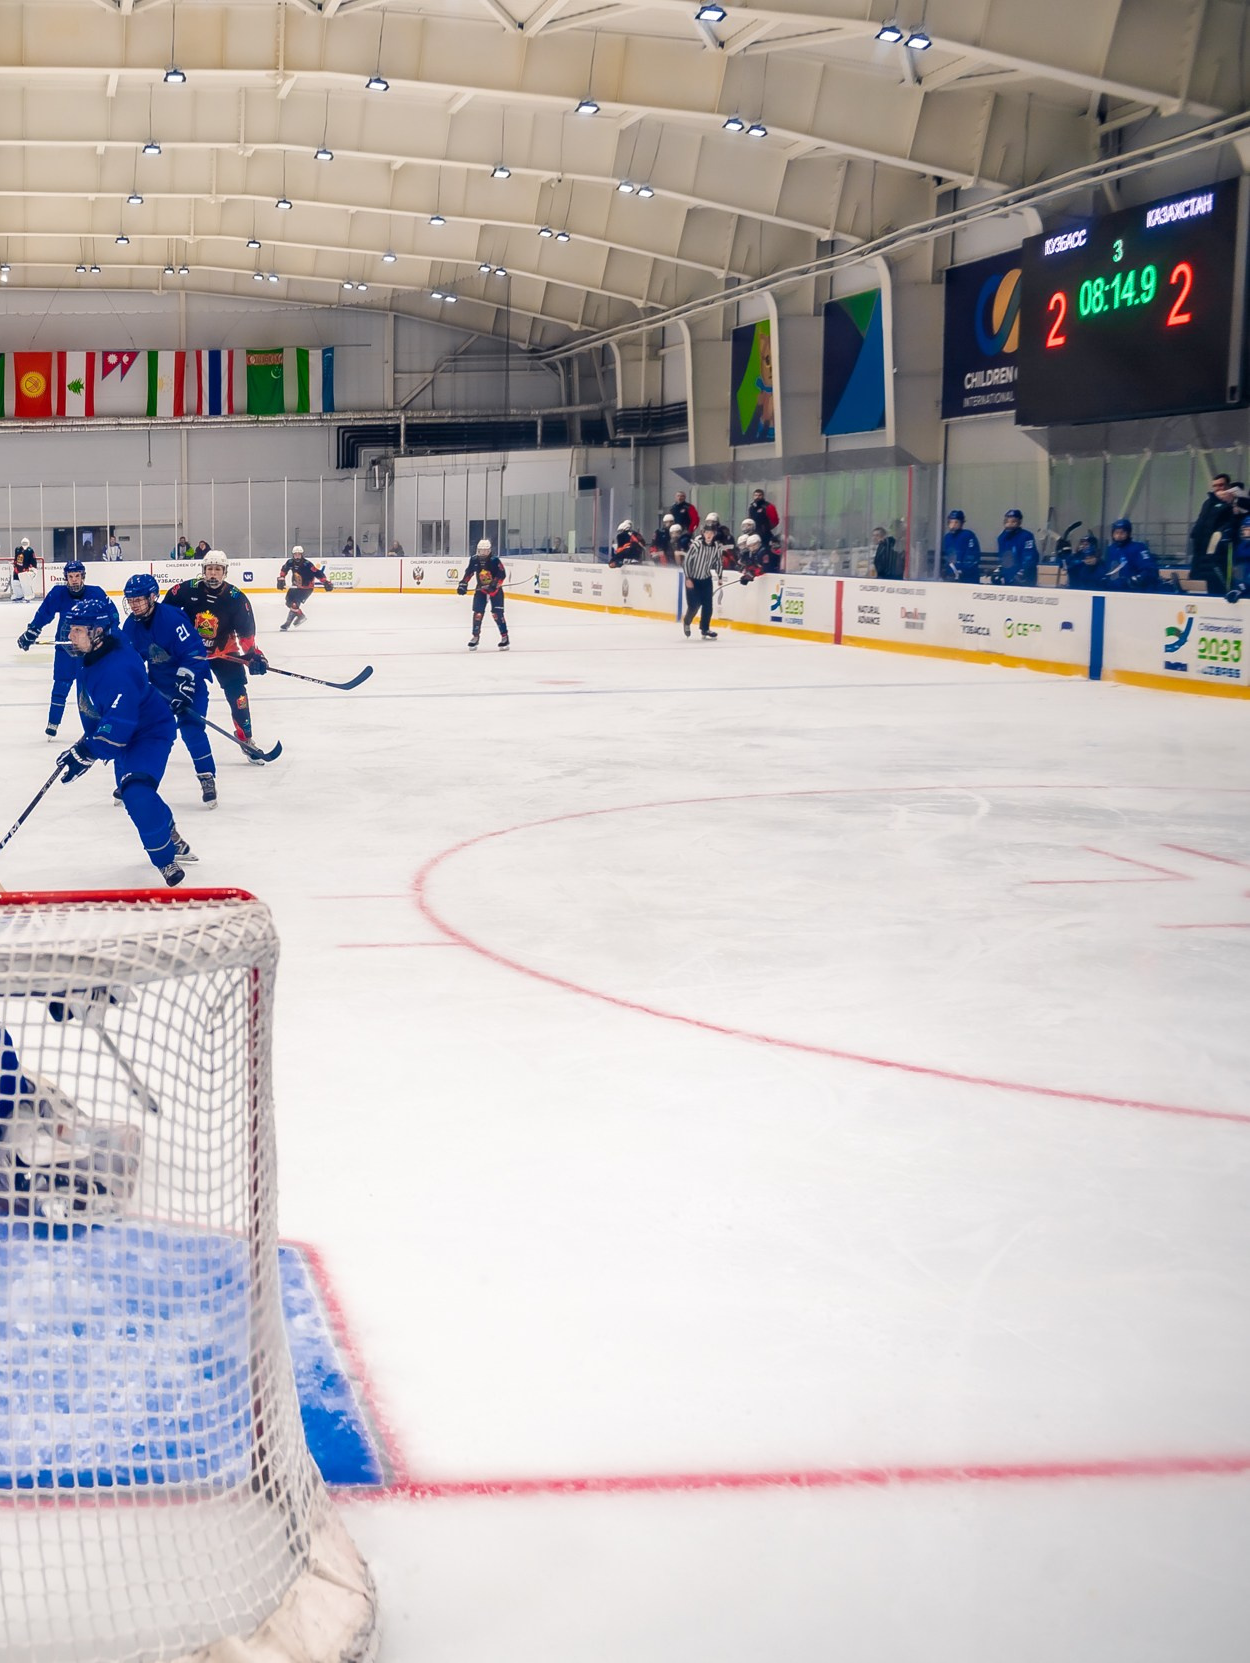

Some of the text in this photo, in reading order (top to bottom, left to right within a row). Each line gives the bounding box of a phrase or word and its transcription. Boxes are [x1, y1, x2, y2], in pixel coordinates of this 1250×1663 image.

[1146, 193, 1214, 229] КАЗАХСТАН
[1044, 229, 1087, 256] КУЗБАСС
[1112, 239, 1124, 262] 3
[1079, 264, 1157, 316] 08:14.9
[1166, 261, 1193, 326] 2
[1046, 291, 1067, 348] 2
[964, 366, 1013, 389] CHILDREN
[330, 571, 353, 580] 2023
[176, 623, 191, 642] 21
[1197, 637, 1242, 662] 2023
